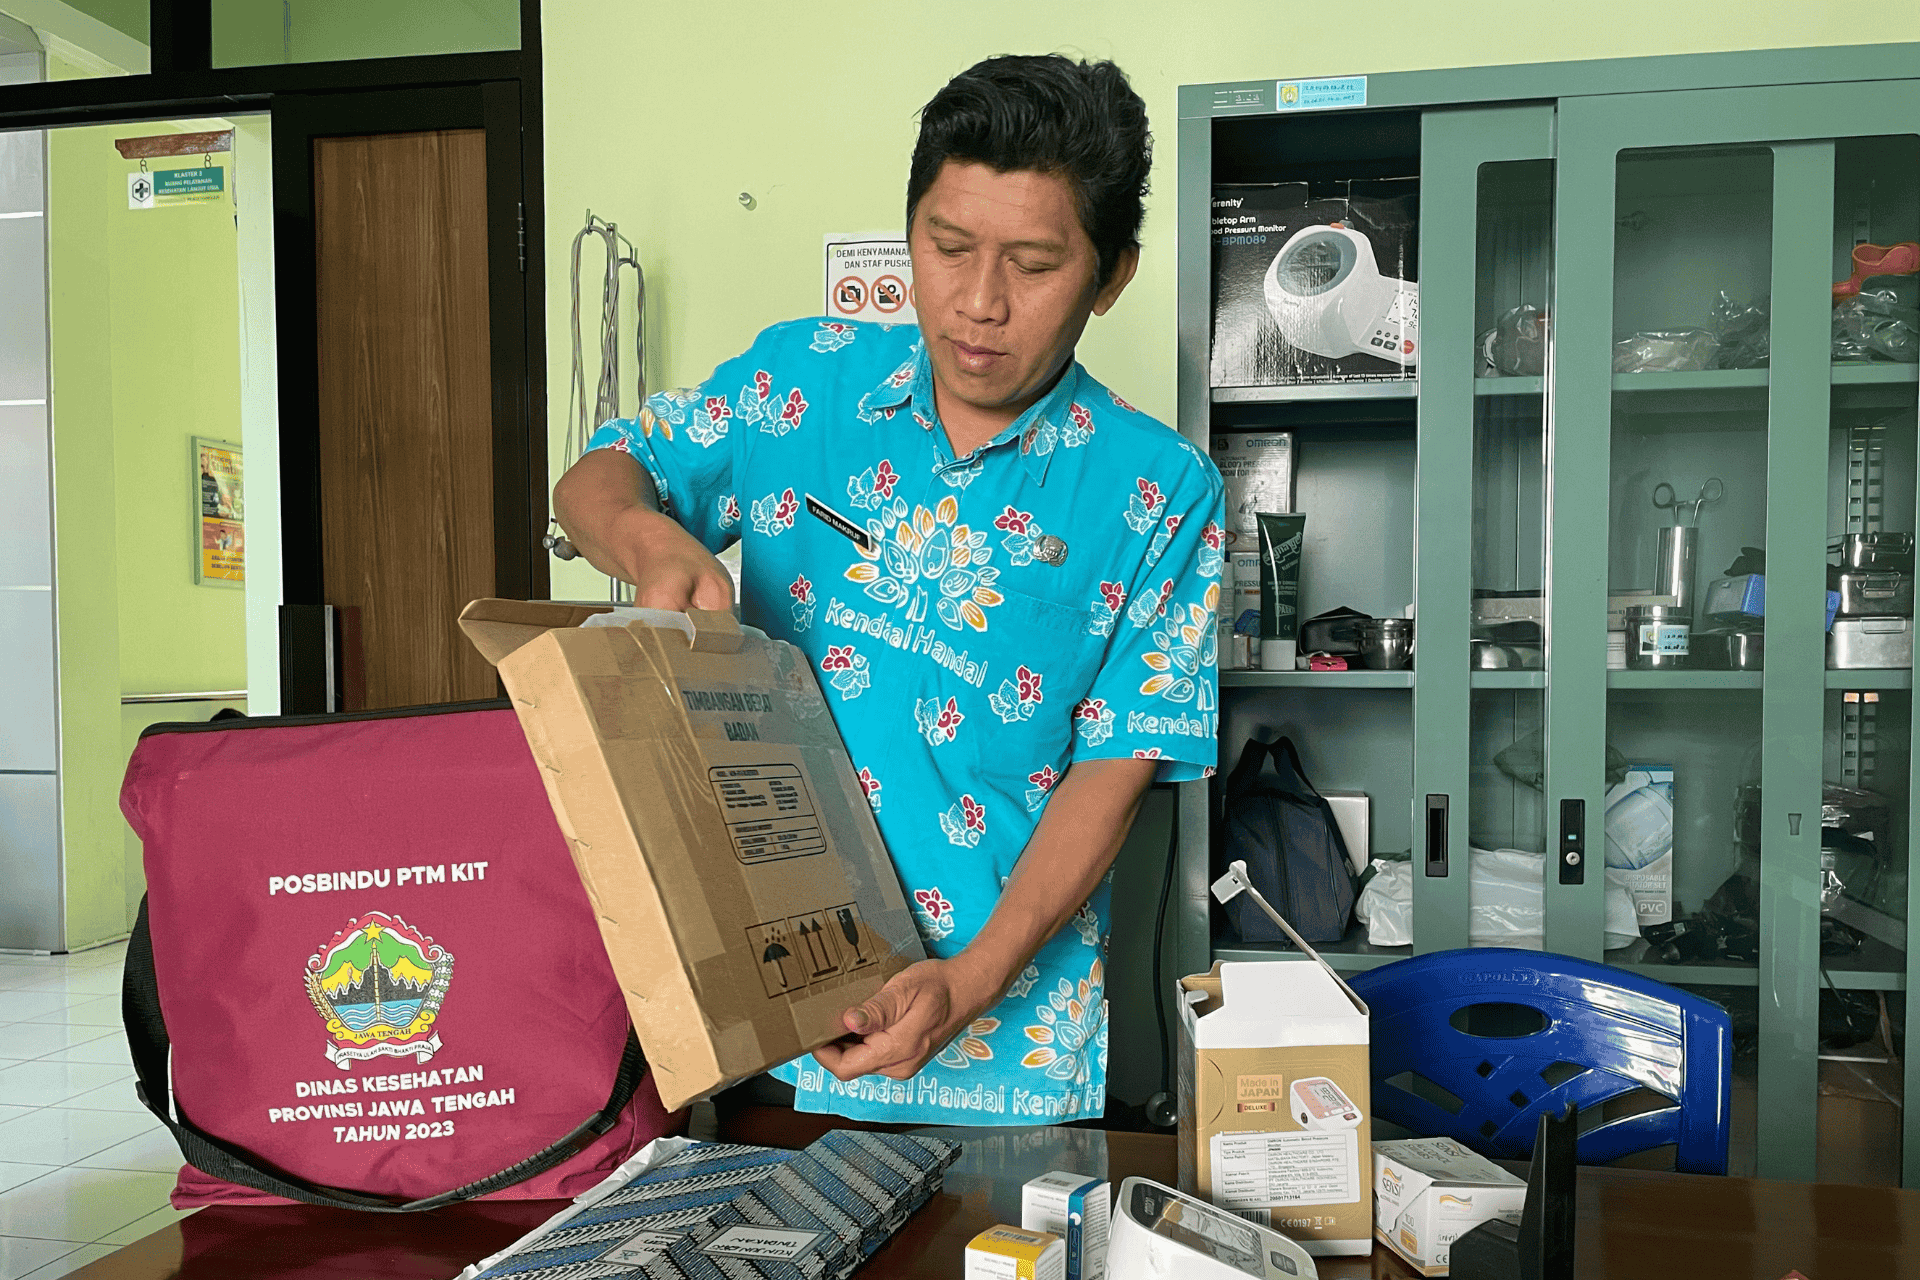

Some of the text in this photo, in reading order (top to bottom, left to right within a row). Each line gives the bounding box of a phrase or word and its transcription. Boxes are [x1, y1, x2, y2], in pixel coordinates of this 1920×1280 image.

[1211, 197, 1242, 209] erenity
[1212, 215, 1256, 226] bletop Arm
[1224, 226, 1256, 235] Pressure
[1258, 224, 1287, 233] Monitor
[1213, 235, 1267, 246] -BPM089
[836, 249, 856, 258] DEMI
[844, 259, 913, 269] DAN STAF PUSKE
[1237, 559, 1260, 568] OMR
[1235, 580, 1260, 588] PRESSU
[825, 597, 989, 688] Kendal Handal
[1127, 711, 1210, 739] Kendal
[723, 721, 760, 742] BADAN
[269, 861, 489, 895] POSBINDU PTM KIT
[1640, 903, 1663, 913] PVC
[354, 1028, 411, 1040] JAWA TENGAH
[296, 1065, 484, 1098] DINAS KESEHATAN
[1240, 1078, 1279, 1087] Made in
[918, 1076, 1005, 1114] Handal
[1013, 1087, 1079, 1116] Kenda
[1240, 1087, 1279, 1097] JAPAN
[268, 1088, 515, 1123] PROVINSI JAWA TENGAH
[333, 1120, 455, 1143] TAHUN 2023
[1382, 1177, 1401, 1198] SENSI
